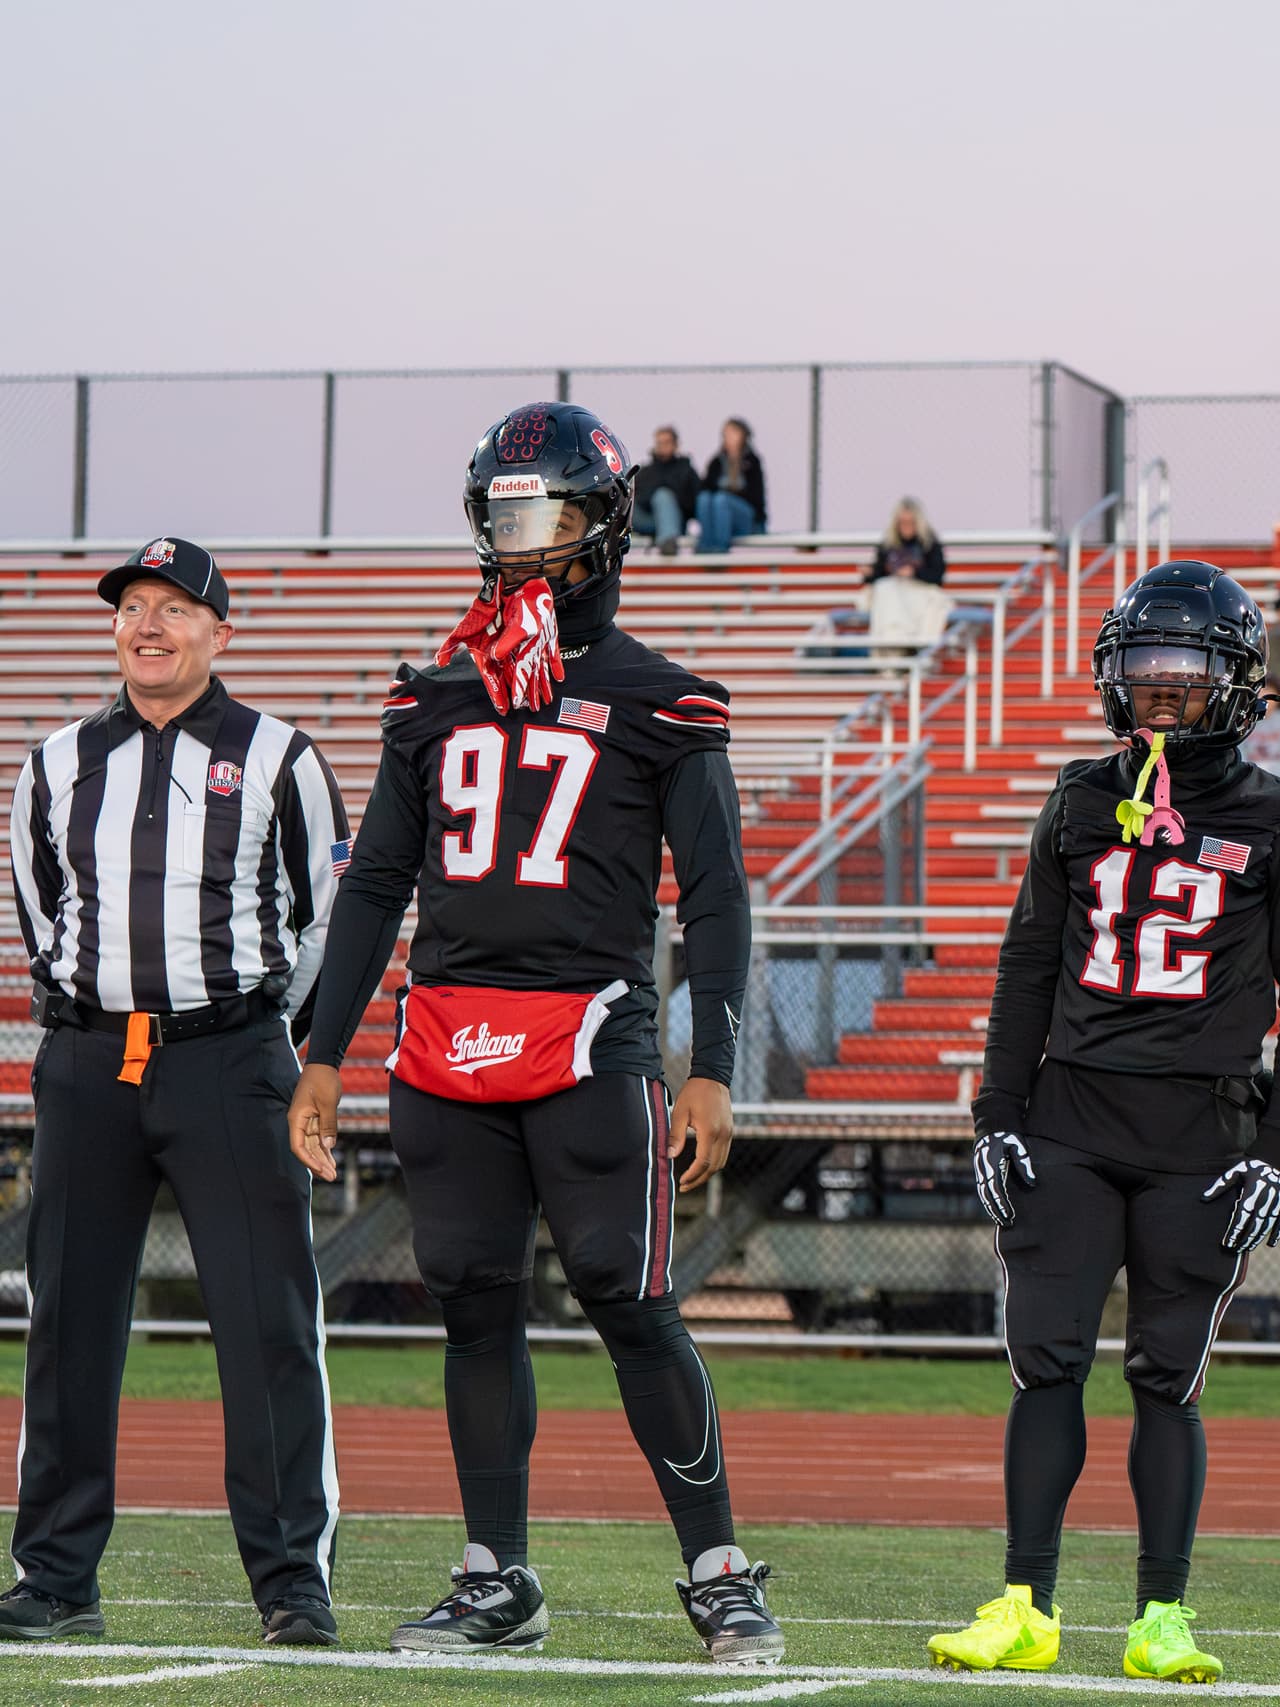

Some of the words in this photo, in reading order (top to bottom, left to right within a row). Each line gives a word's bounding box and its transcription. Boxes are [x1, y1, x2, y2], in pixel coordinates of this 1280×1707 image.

[492, 479, 539, 493] Riddell
[439, 722, 600, 889] 97
[1079, 845, 1227, 999] 12
[445, 1022, 527, 1063] Indiana
